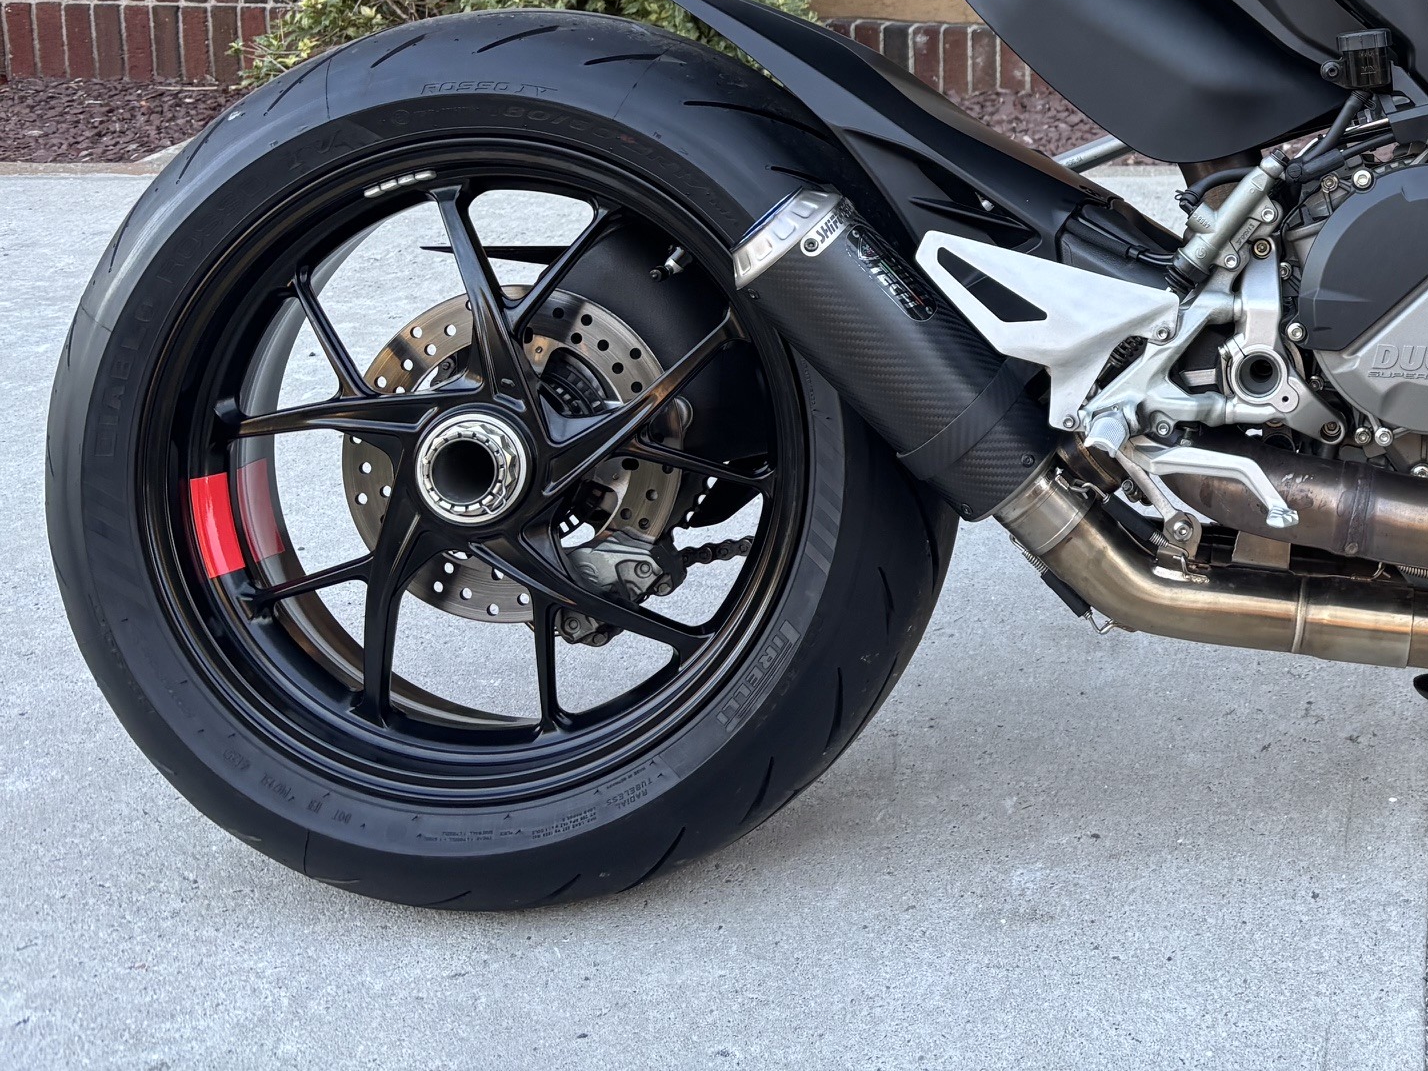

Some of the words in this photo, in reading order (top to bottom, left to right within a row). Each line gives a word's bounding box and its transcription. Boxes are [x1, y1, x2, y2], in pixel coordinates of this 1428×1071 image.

[420, 81, 510, 95] ROSSO
[715, 619, 801, 733] PIRELLI
[606, 777, 653, 806] TUBELESS
[615, 788, 648, 809] RADIAL
